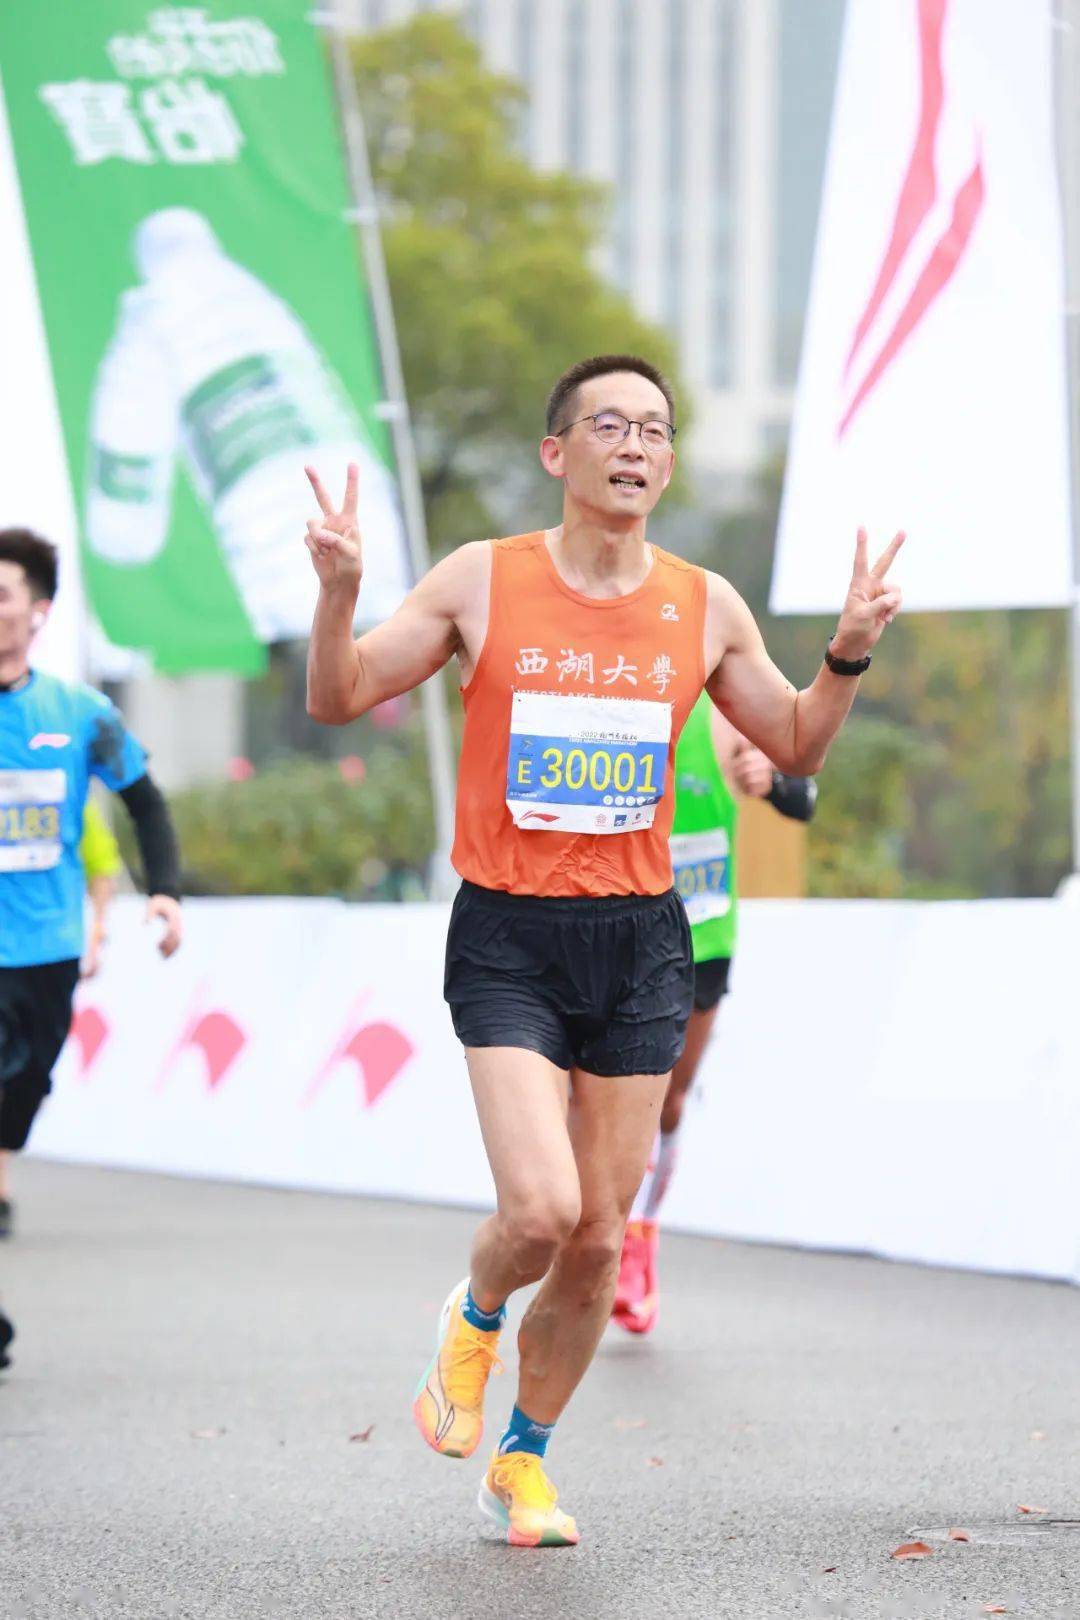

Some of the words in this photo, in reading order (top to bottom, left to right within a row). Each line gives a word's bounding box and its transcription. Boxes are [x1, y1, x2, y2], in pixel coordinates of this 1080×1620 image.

[514, 647, 677, 695] 西湖大學
[517, 760, 532, 784] E
[540, 747, 657, 793] 30001
